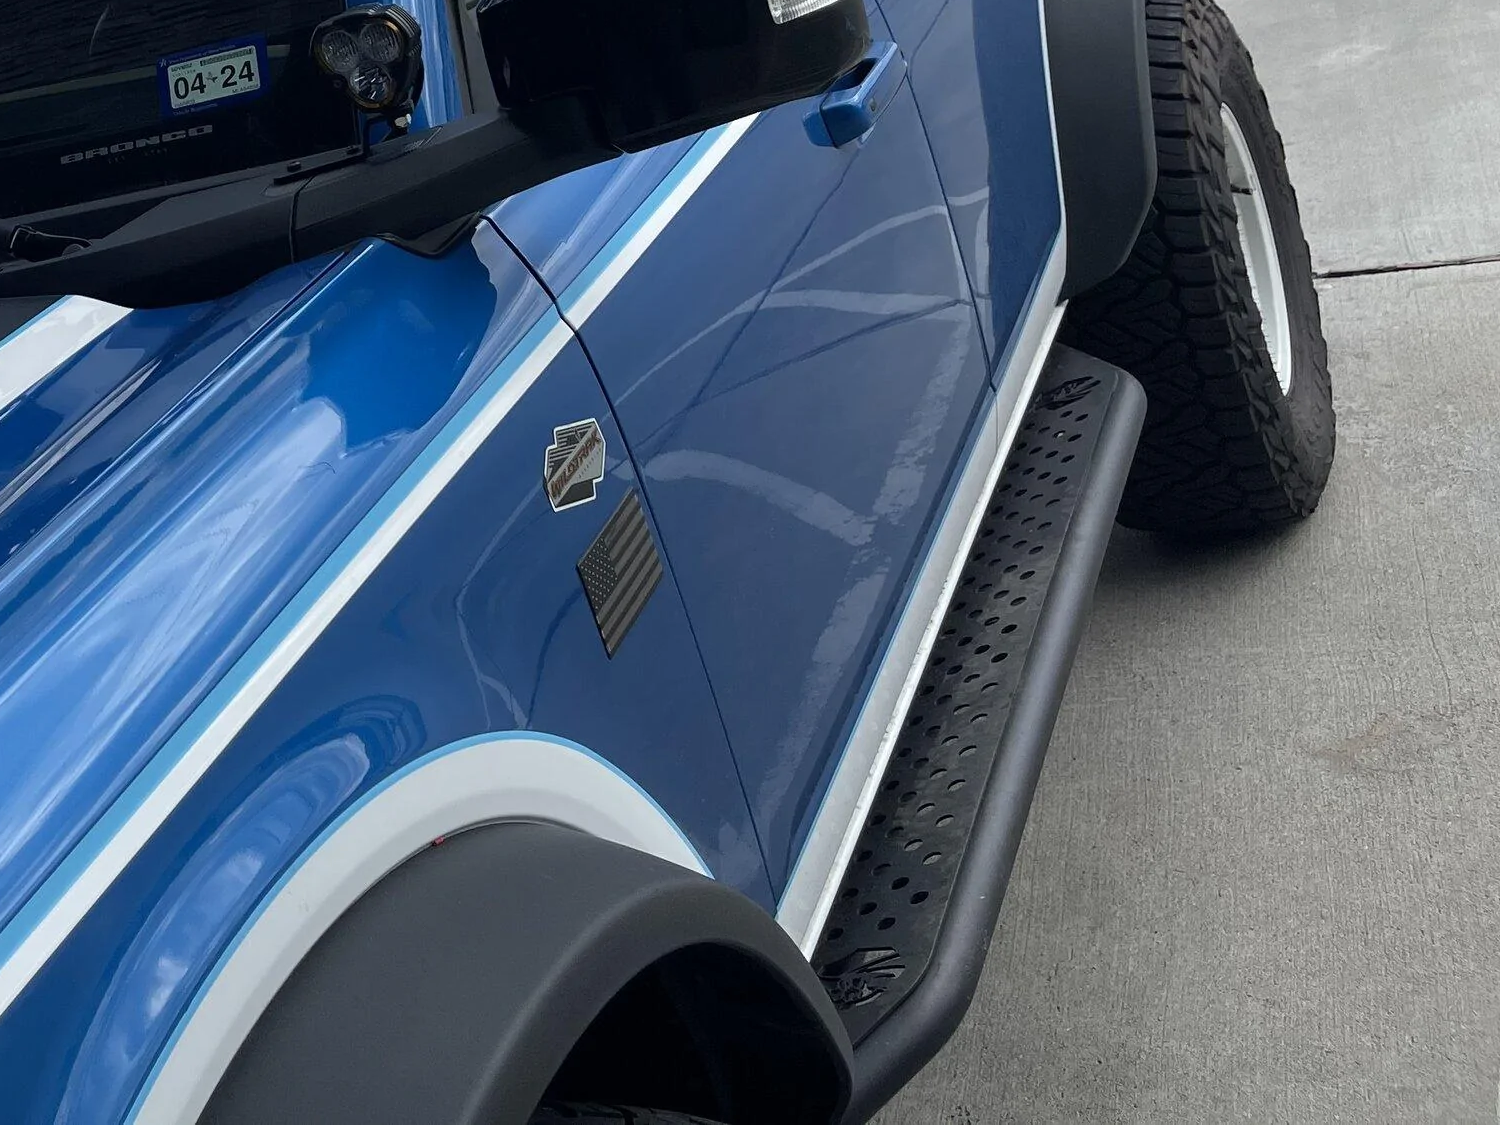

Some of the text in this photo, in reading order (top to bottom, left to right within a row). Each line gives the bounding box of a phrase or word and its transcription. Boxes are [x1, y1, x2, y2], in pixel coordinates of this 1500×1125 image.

[173, 60, 255, 100] 04 24
[60, 124, 213, 165] BRONCO
